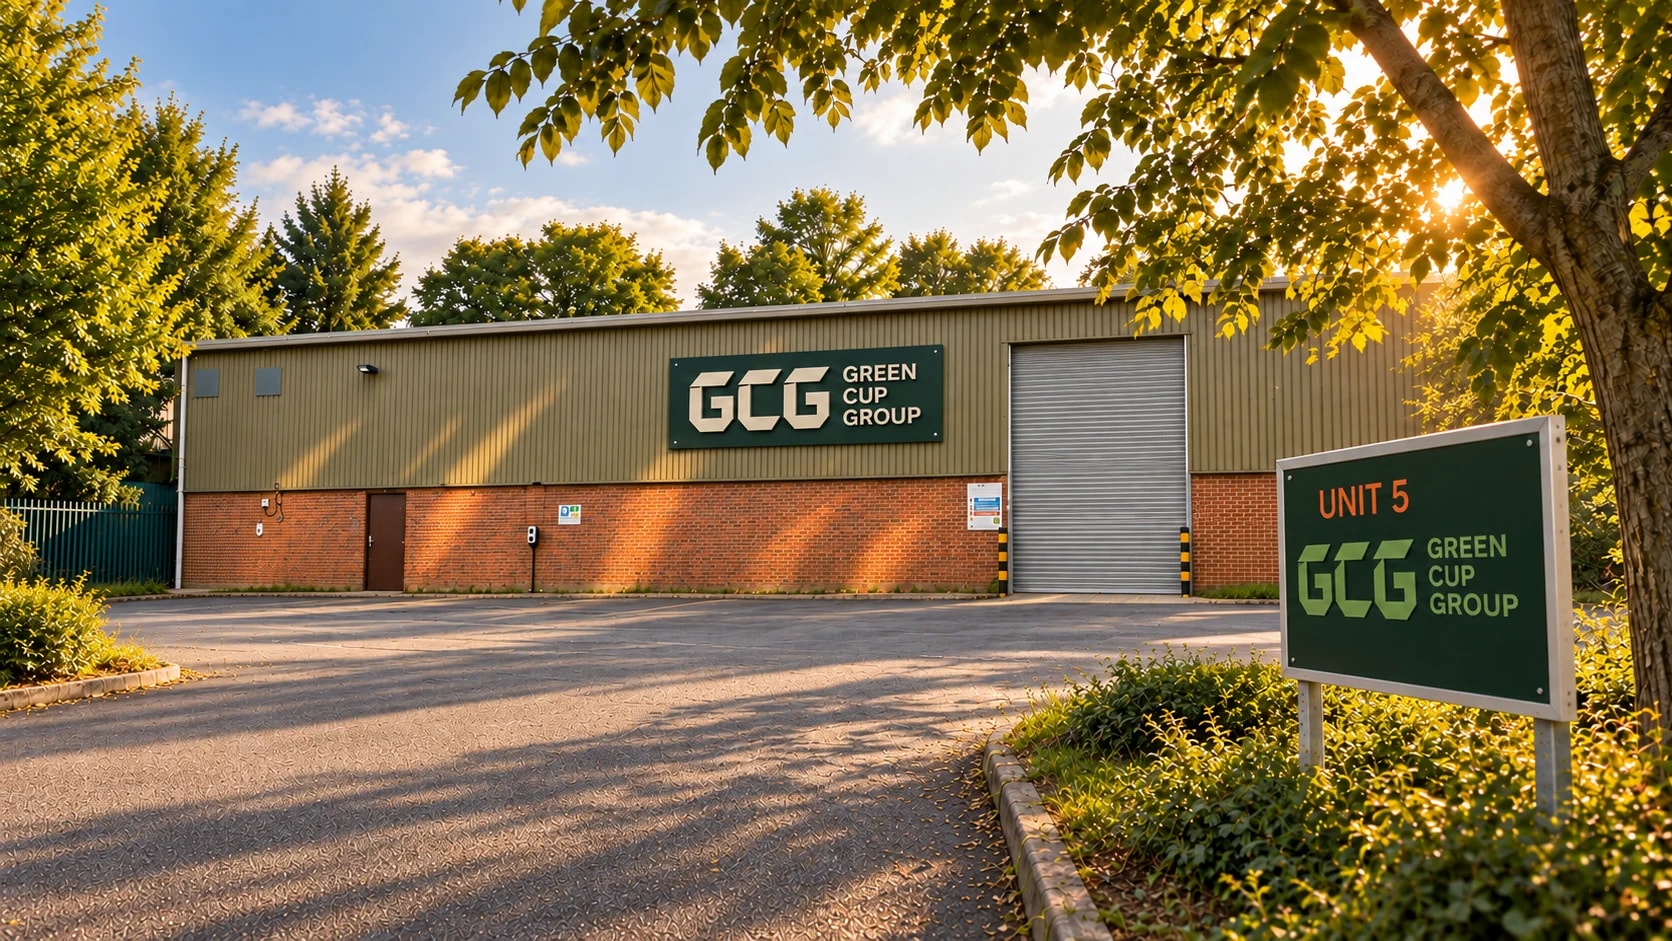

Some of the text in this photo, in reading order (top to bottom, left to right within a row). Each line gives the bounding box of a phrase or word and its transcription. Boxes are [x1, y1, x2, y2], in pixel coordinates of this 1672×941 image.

[842, 363, 917, 383] GREEN
[689, 366, 830, 433] GCG
[842, 386, 888, 405] CUP
[842, 406, 921, 426] GROUP
[1319, 479, 1409, 519] UNIT 5
[1427, 534, 1507, 559] GREEN
[1297, 538, 1417, 621] GCG
[1428, 565, 1475, 587] CUP
[1429, 592, 1519, 618] GROUP
